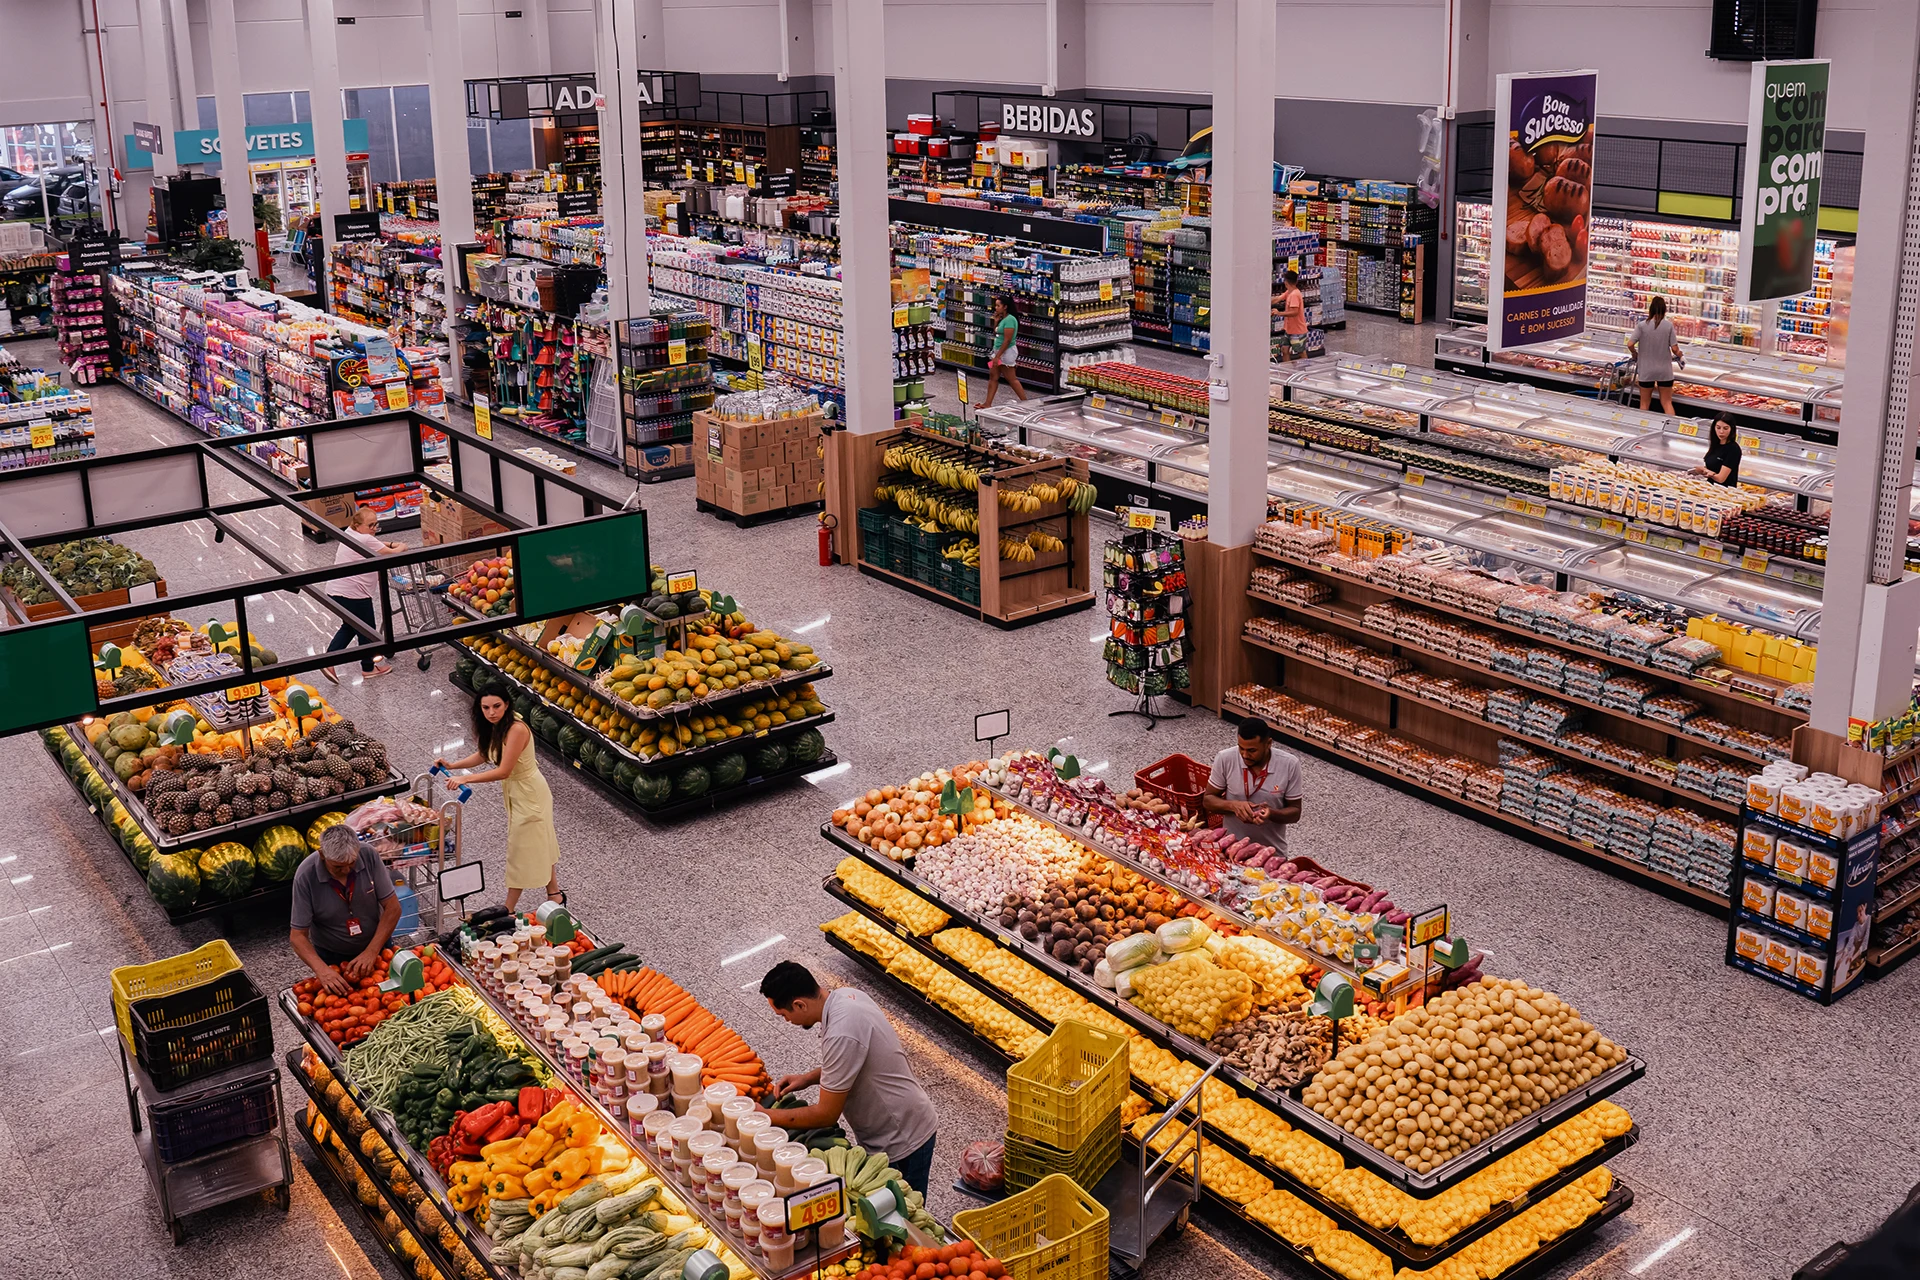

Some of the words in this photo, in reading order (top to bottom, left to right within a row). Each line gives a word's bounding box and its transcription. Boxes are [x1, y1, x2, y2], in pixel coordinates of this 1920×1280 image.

[555, 82, 652, 110] ADA
[1766, 82, 1806, 103] quem
[1542, 95, 1570, 115] Bom
[1003, 104, 1094, 136] BEBIDAS
[1525, 114, 1584, 144] Sucesso
[200, 132, 302, 154] SVETES
[1762, 120, 1824, 163] para
[1770, 151, 1822, 184] com
[1757, 183, 1808, 226] pra
[1507, 310, 1538, 322] CARNES
[1541, 308, 1550, 317] DE
[1552, 300, 1584, 316] QUALIDADE
[1520, 324, 1525, 334] É
[1528, 323, 1545, 333] BOM
[1547, 316, 1576, 330] SUCESSO!
[192, 1032, 209, 1042] VINTE
[214, 1025, 230, 1035] VINTE
[809, 1187, 832, 1197] Superviza
[1036, 1263, 1051, 1275] VINTE
[1056, 1254, 1071, 1265] VINTE
